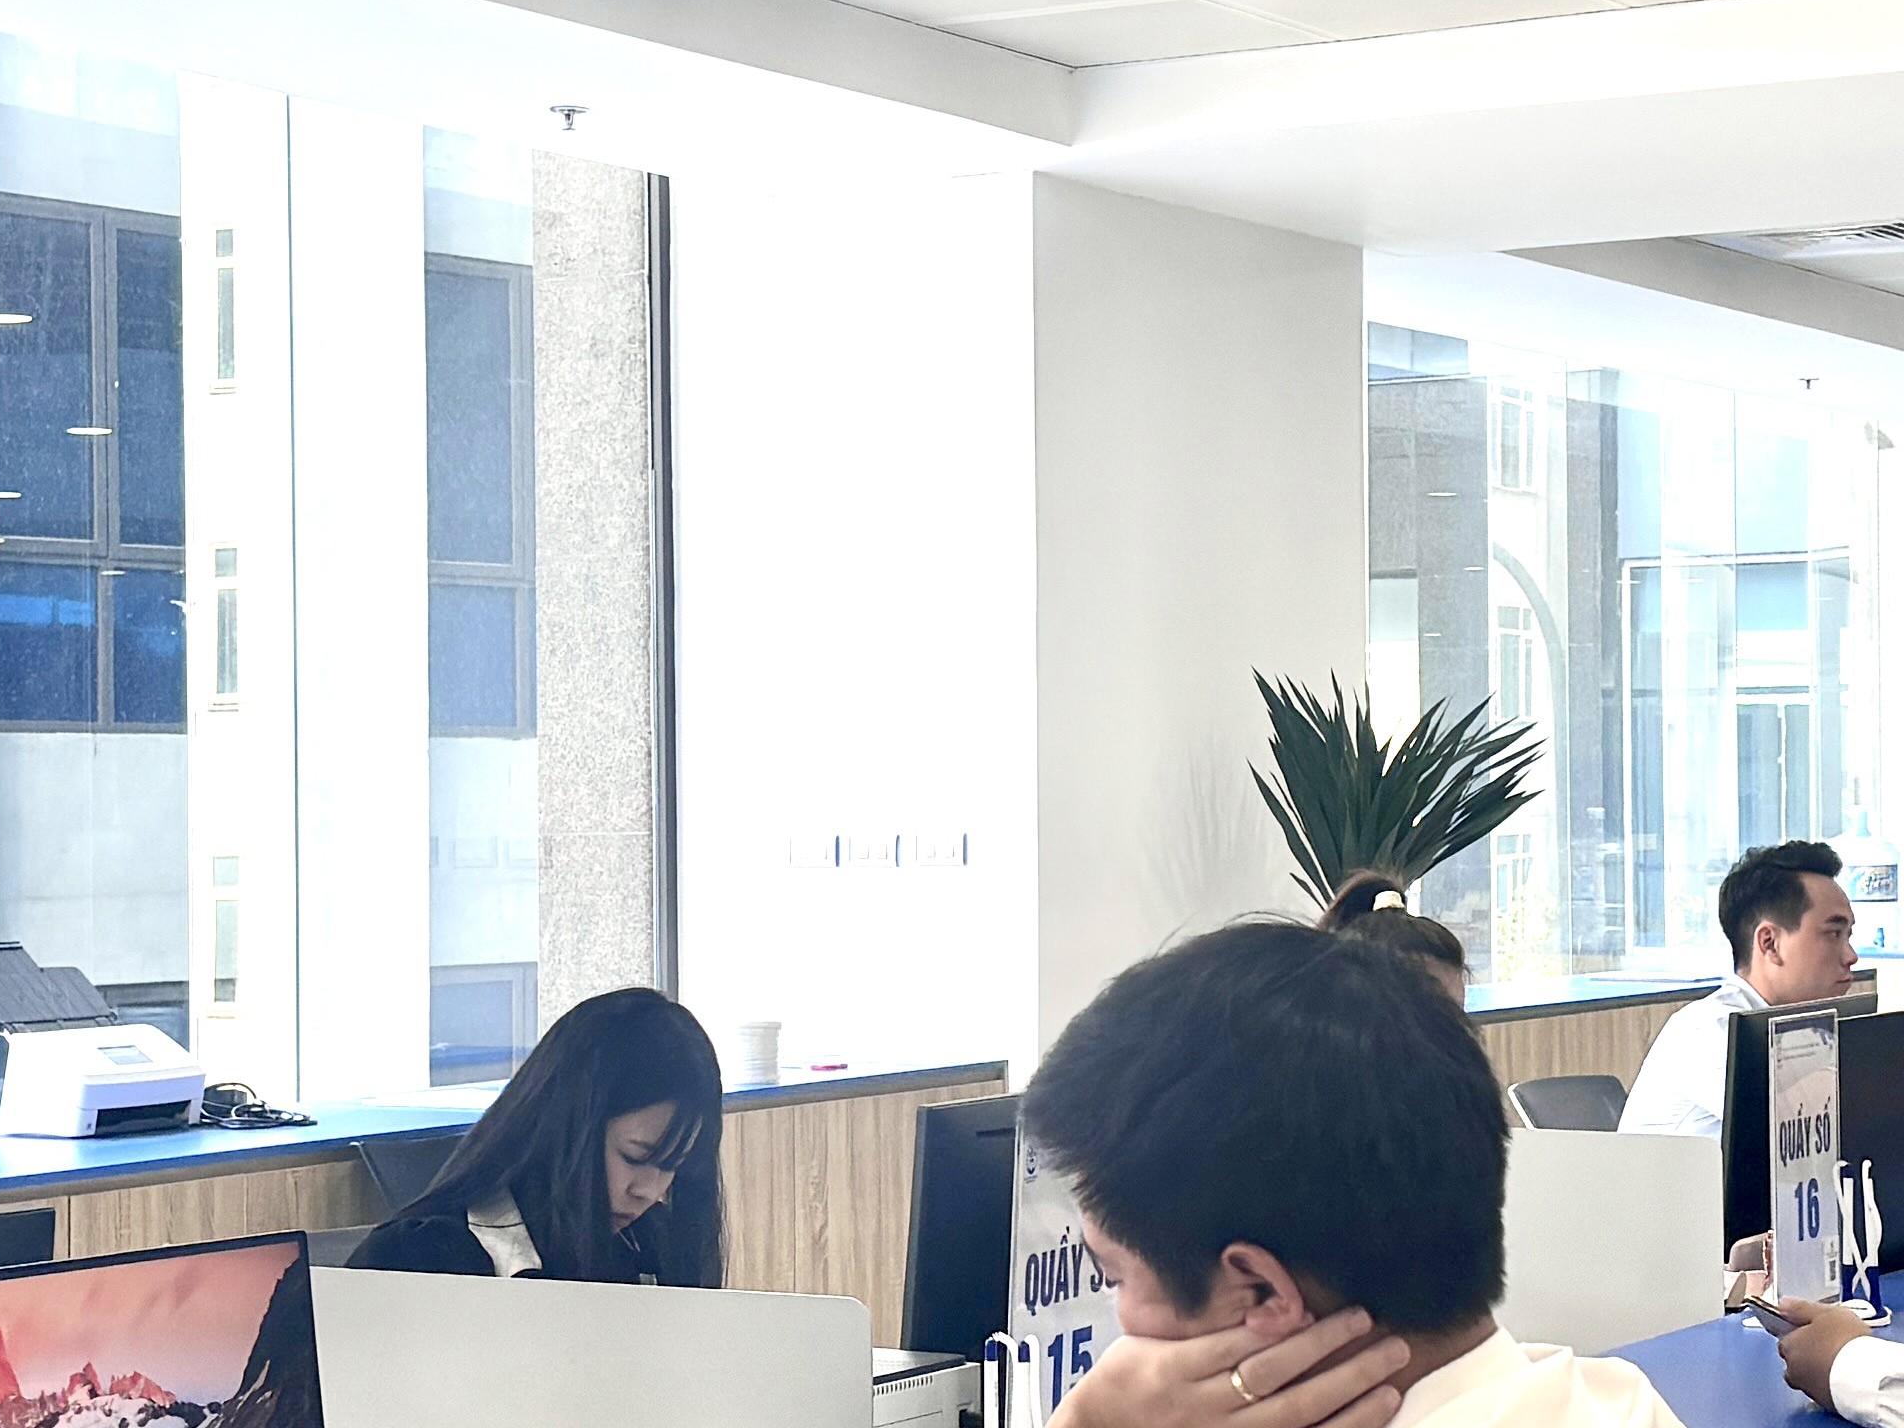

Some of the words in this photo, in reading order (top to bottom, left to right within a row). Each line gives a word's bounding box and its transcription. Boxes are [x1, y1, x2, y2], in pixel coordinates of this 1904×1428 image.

[1779, 1103, 1811, 1167] QUẦY
[1815, 1097, 1831, 1154] SỐ
[1794, 1178, 1820, 1242] 16
[1024, 1226, 1084, 1316] QUẦY
